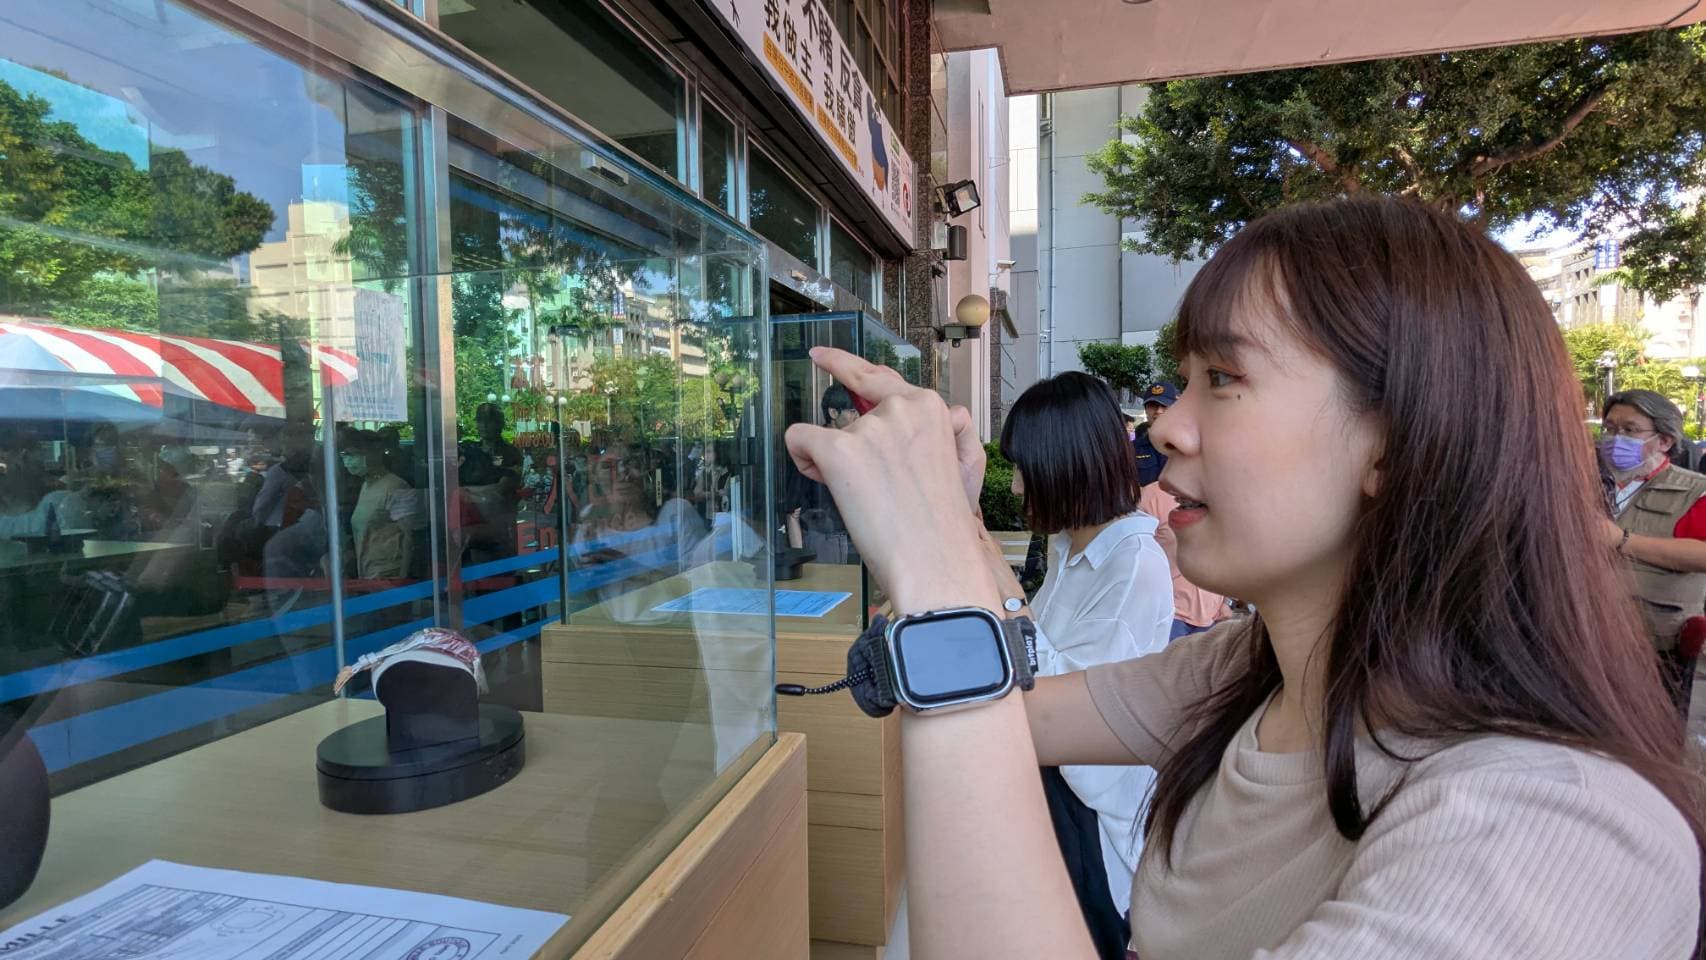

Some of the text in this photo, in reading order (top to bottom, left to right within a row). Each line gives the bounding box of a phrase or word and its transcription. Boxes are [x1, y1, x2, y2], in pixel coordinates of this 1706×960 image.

[763, 0, 813, 87] 我做主
[1024, 634, 1037, 666] bitplay
